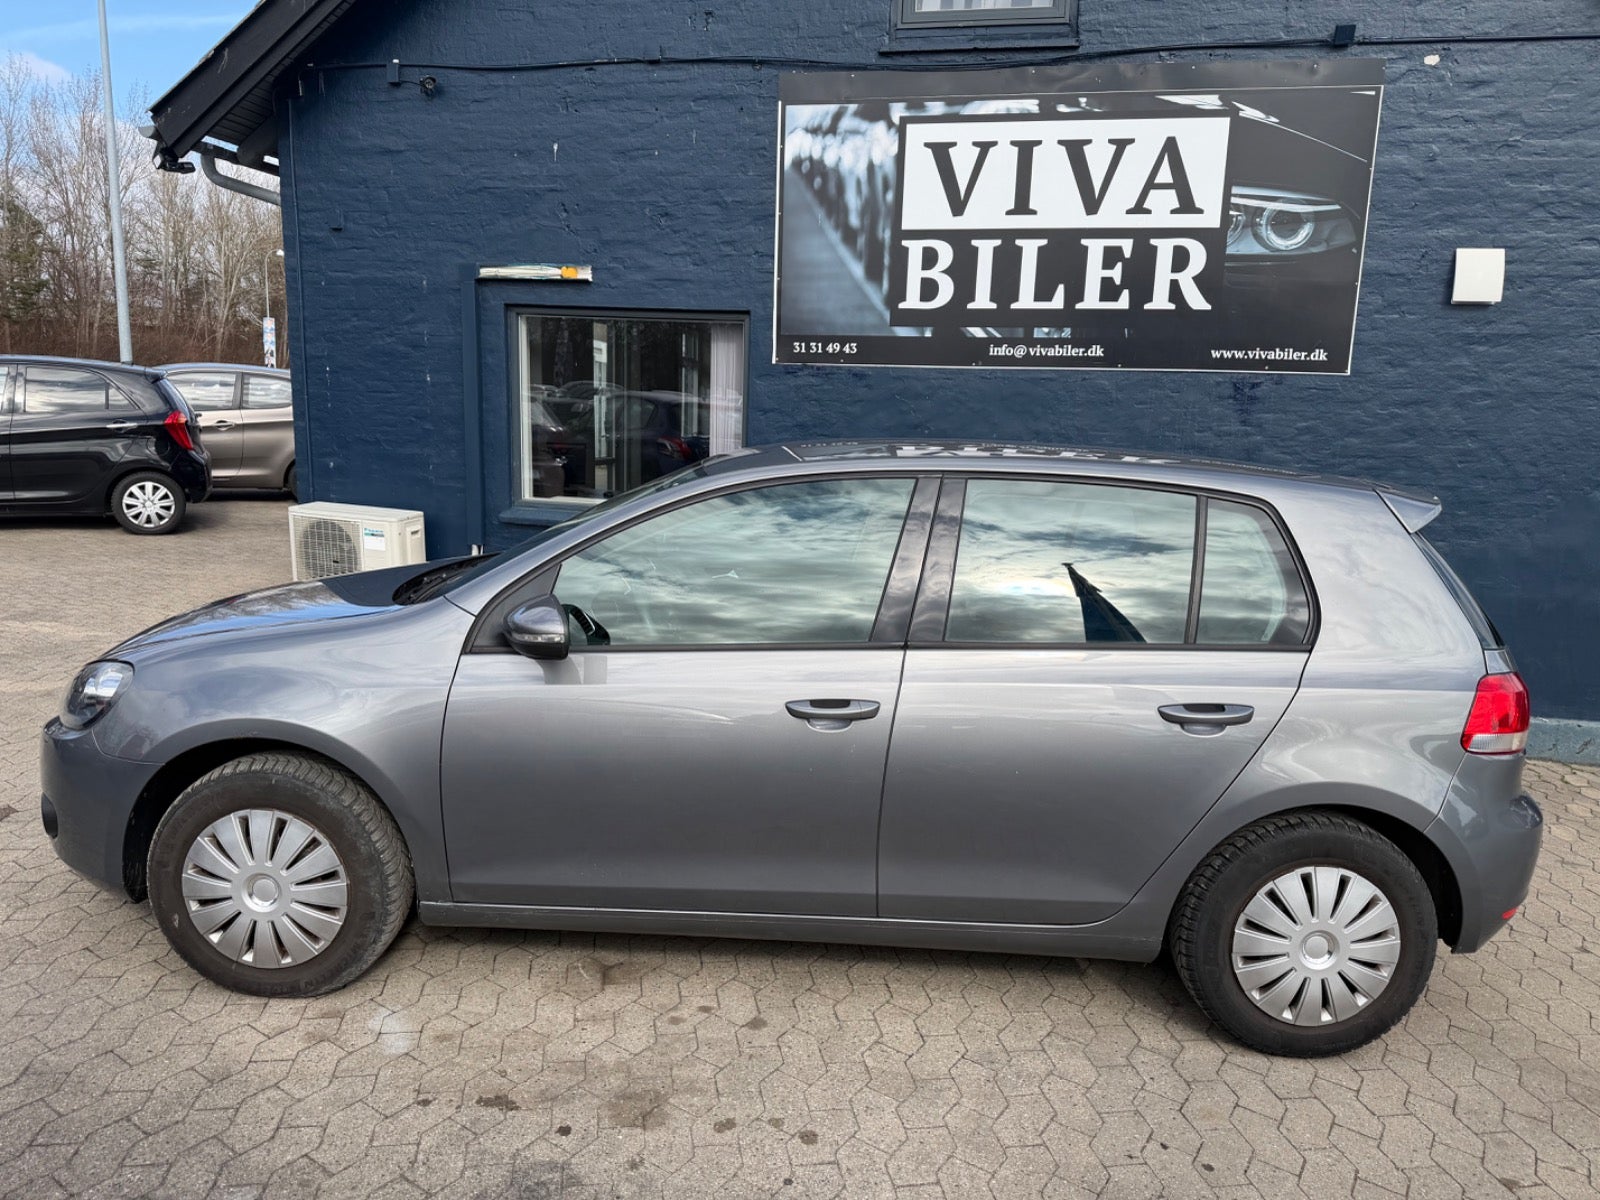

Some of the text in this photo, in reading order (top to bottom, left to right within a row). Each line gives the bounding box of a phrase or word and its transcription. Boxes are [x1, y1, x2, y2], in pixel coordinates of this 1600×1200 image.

[923, 136, 1204, 217] VIVA
[897, 237, 1212, 311] BILER
[793, 342, 858, 354] 31 31 49 43
[989, 344, 1104, 358] info@vivabiler.dk
[1210, 347, 1328, 361] www.vivabiler.dk
